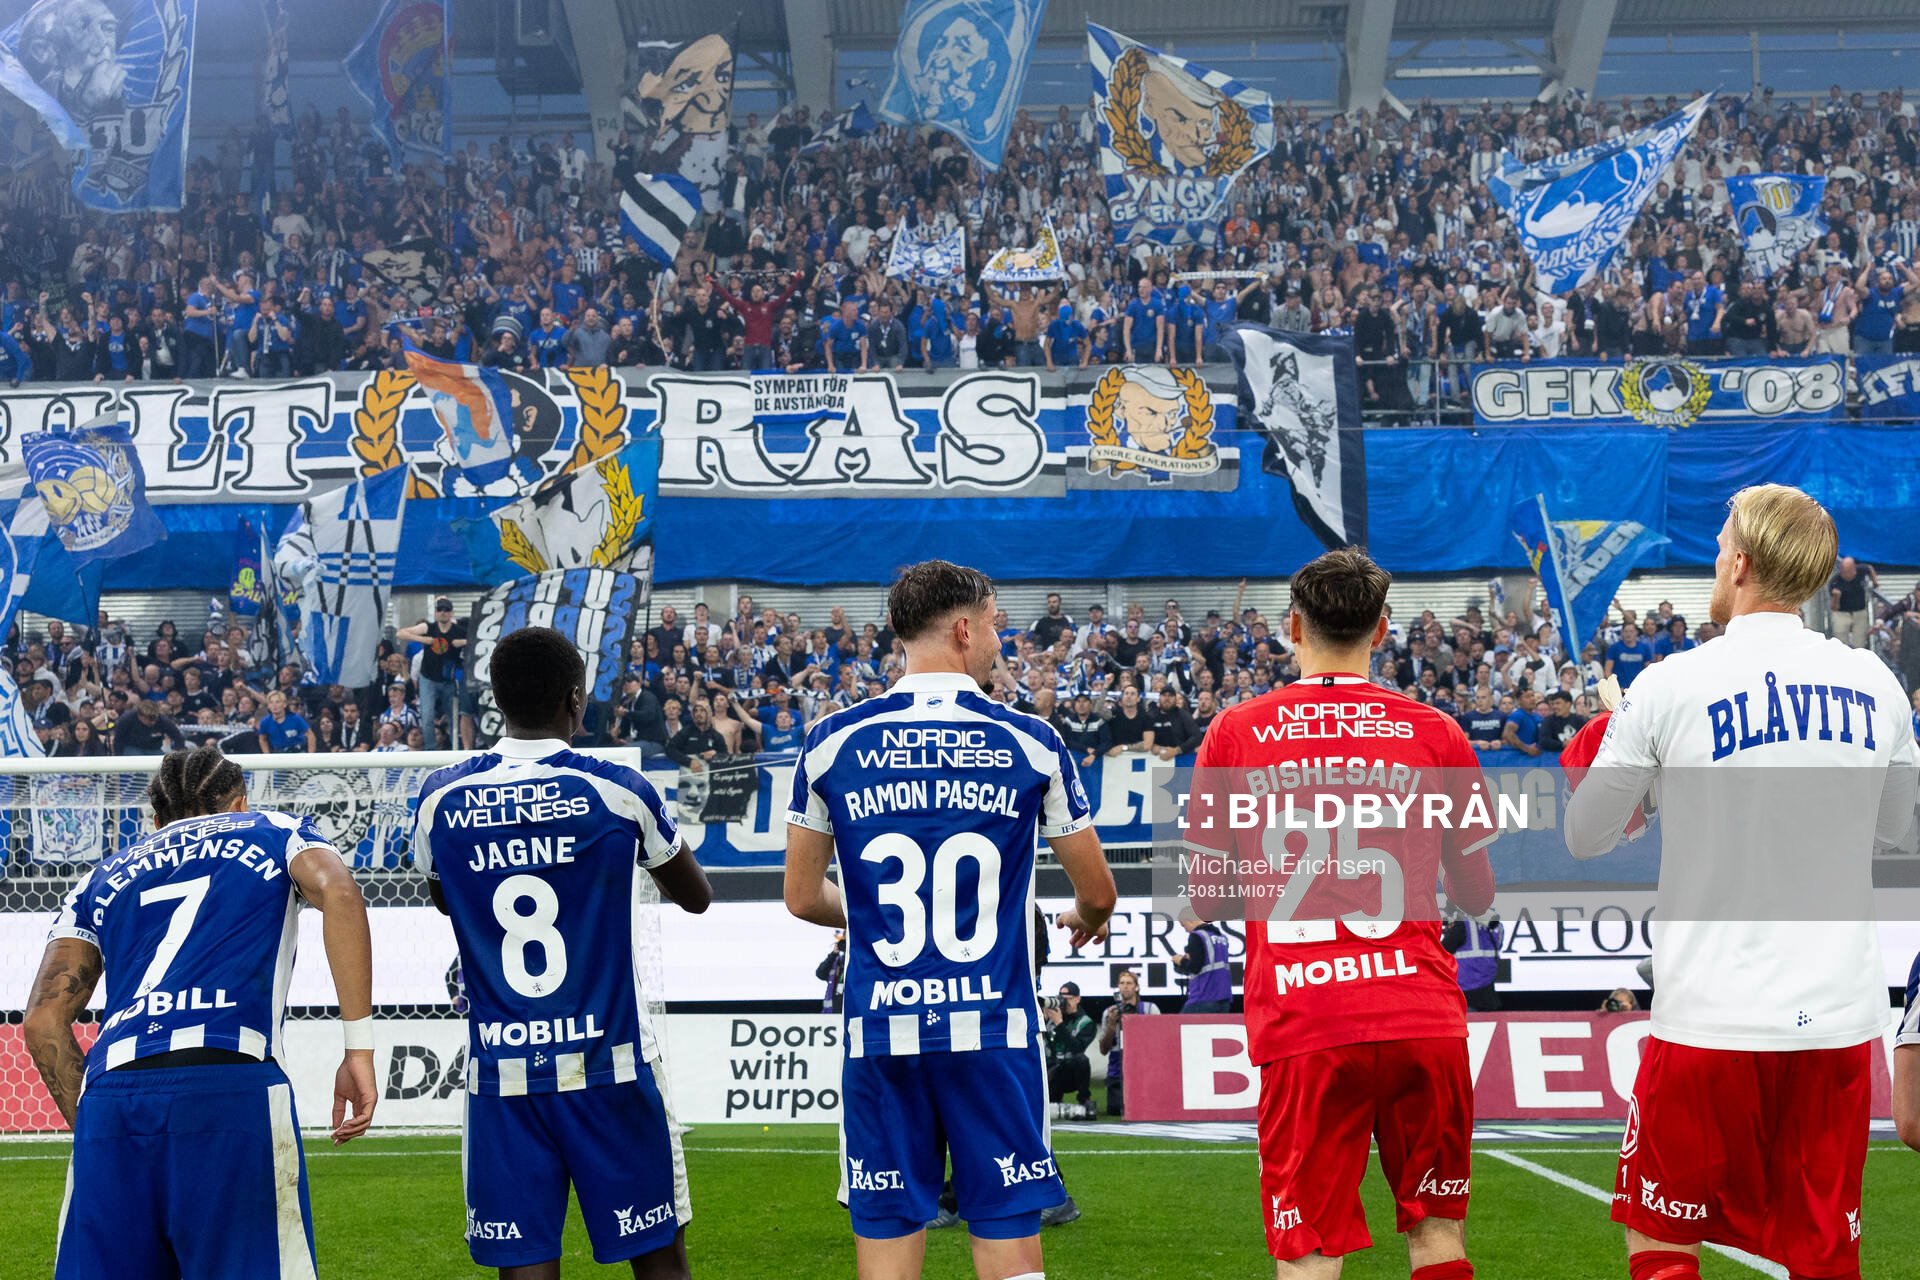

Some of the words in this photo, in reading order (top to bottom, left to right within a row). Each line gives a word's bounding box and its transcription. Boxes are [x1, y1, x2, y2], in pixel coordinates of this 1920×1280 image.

[754, 379, 819, 395] SYMPATI
[823, 375, 848, 393] FÖR
[1473, 367, 1625, 419] GFK
[754, 398, 772, 411] DE
[648, 372, 1046, 490] RAS
[1096, 449, 1131, 461] YNGRE
[1277, 702, 1386, 722] NORDIC
[1706, 671, 1876, 762] BLÅVITT
[882, 729, 986, 748] NORDIC
[1252, 720, 1414, 743] WELLNESS
[856, 750, 1013, 768] WELLNESS
[1245, 756, 1422, 798] BISHESARI
[465, 782, 561, 808] NORDIC
[844, 780, 927, 821] RAMON
[935, 780, 1020, 818] PASCAL
[444, 797, 590, 829] WELLNESS
[791, 814, 810, 826] IFK
[1061, 823, 1079, 834] IFK
[468, 836, 576, 872] JAGNE
[1261, 805, 1405, 944] 25
[859, 832, 1001, 968] 30
[133, 874, 211, 1000] 7
[492, 875, 568, 998] 8
[1274, 949, 1417, 996] MOBILL
[869, 975, 1002, 1010] MOBILL
[478, 1013, 604, 1050] MOBILL
[731, 1019, 837, 1047] Doors
[730, 1050, 808, 1080] with
[851, 1170, 904, 1191] RAST
[1001, 1157, 1060, 1187] RAST
[1621, 1164, 1628, 1189] 1
[619, 1202, 675, 1237] RASTA
[1641, 1188, 1708, 1220] RASTA
[468, 1218, 522, 1240] RASTA
